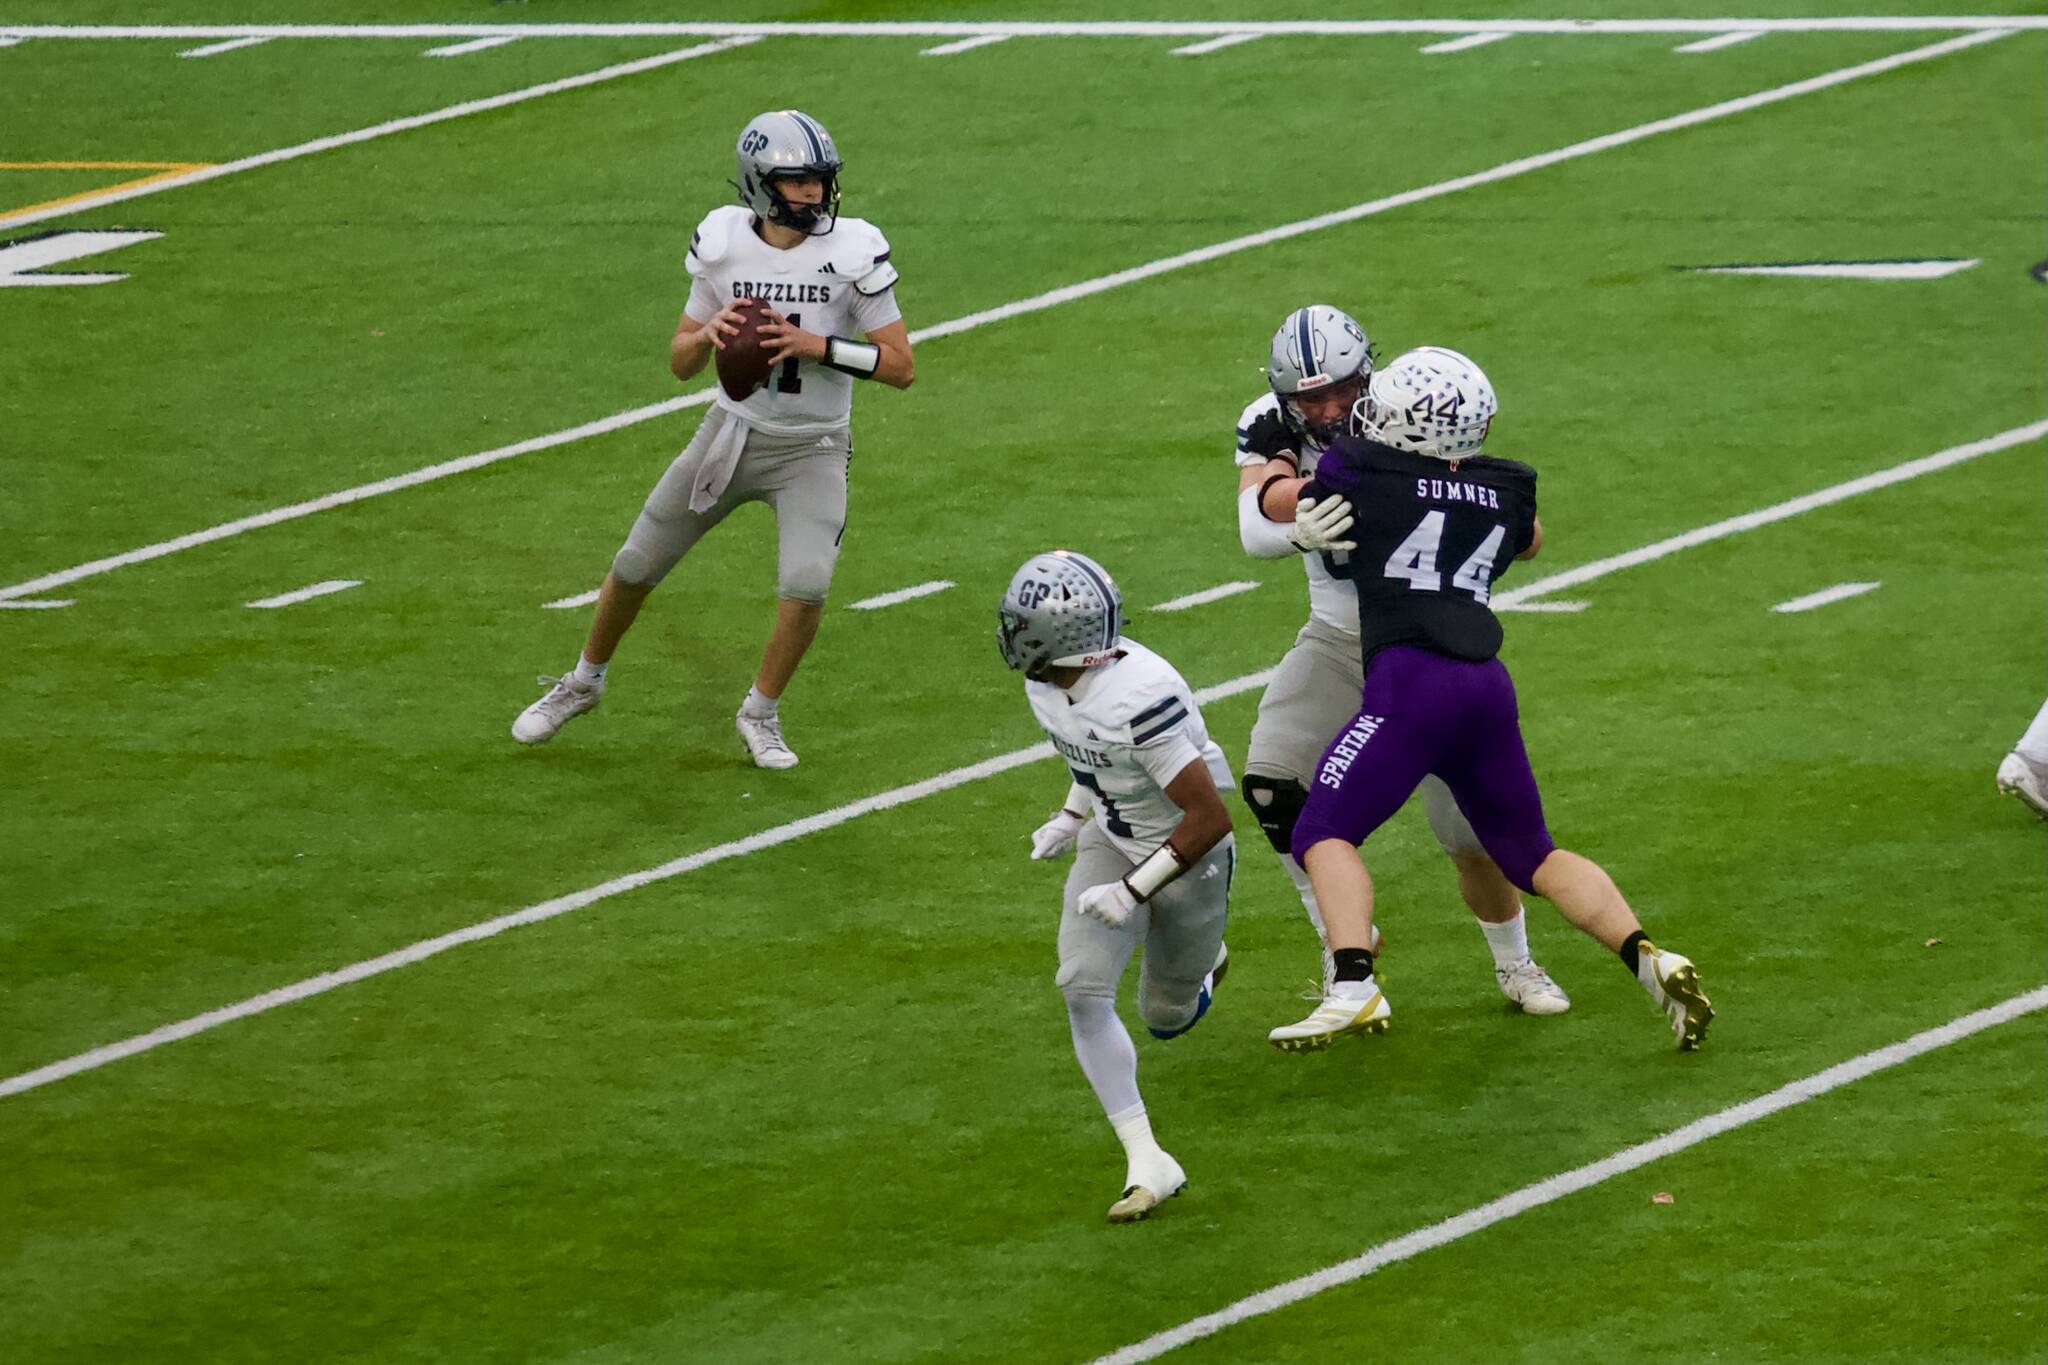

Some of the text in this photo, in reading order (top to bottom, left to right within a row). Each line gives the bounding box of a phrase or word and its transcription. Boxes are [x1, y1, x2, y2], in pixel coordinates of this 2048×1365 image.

[732, 281, 831, 303] GRIZZLIES
[1411, 393, 1459, 426] 44
[1416, 478, 1500, 509] SUMNER
[1383, 509, 1506, 608] 44
[1018, 579, 1051, 610] GP
[1070, 767, 1134, 838] 7
